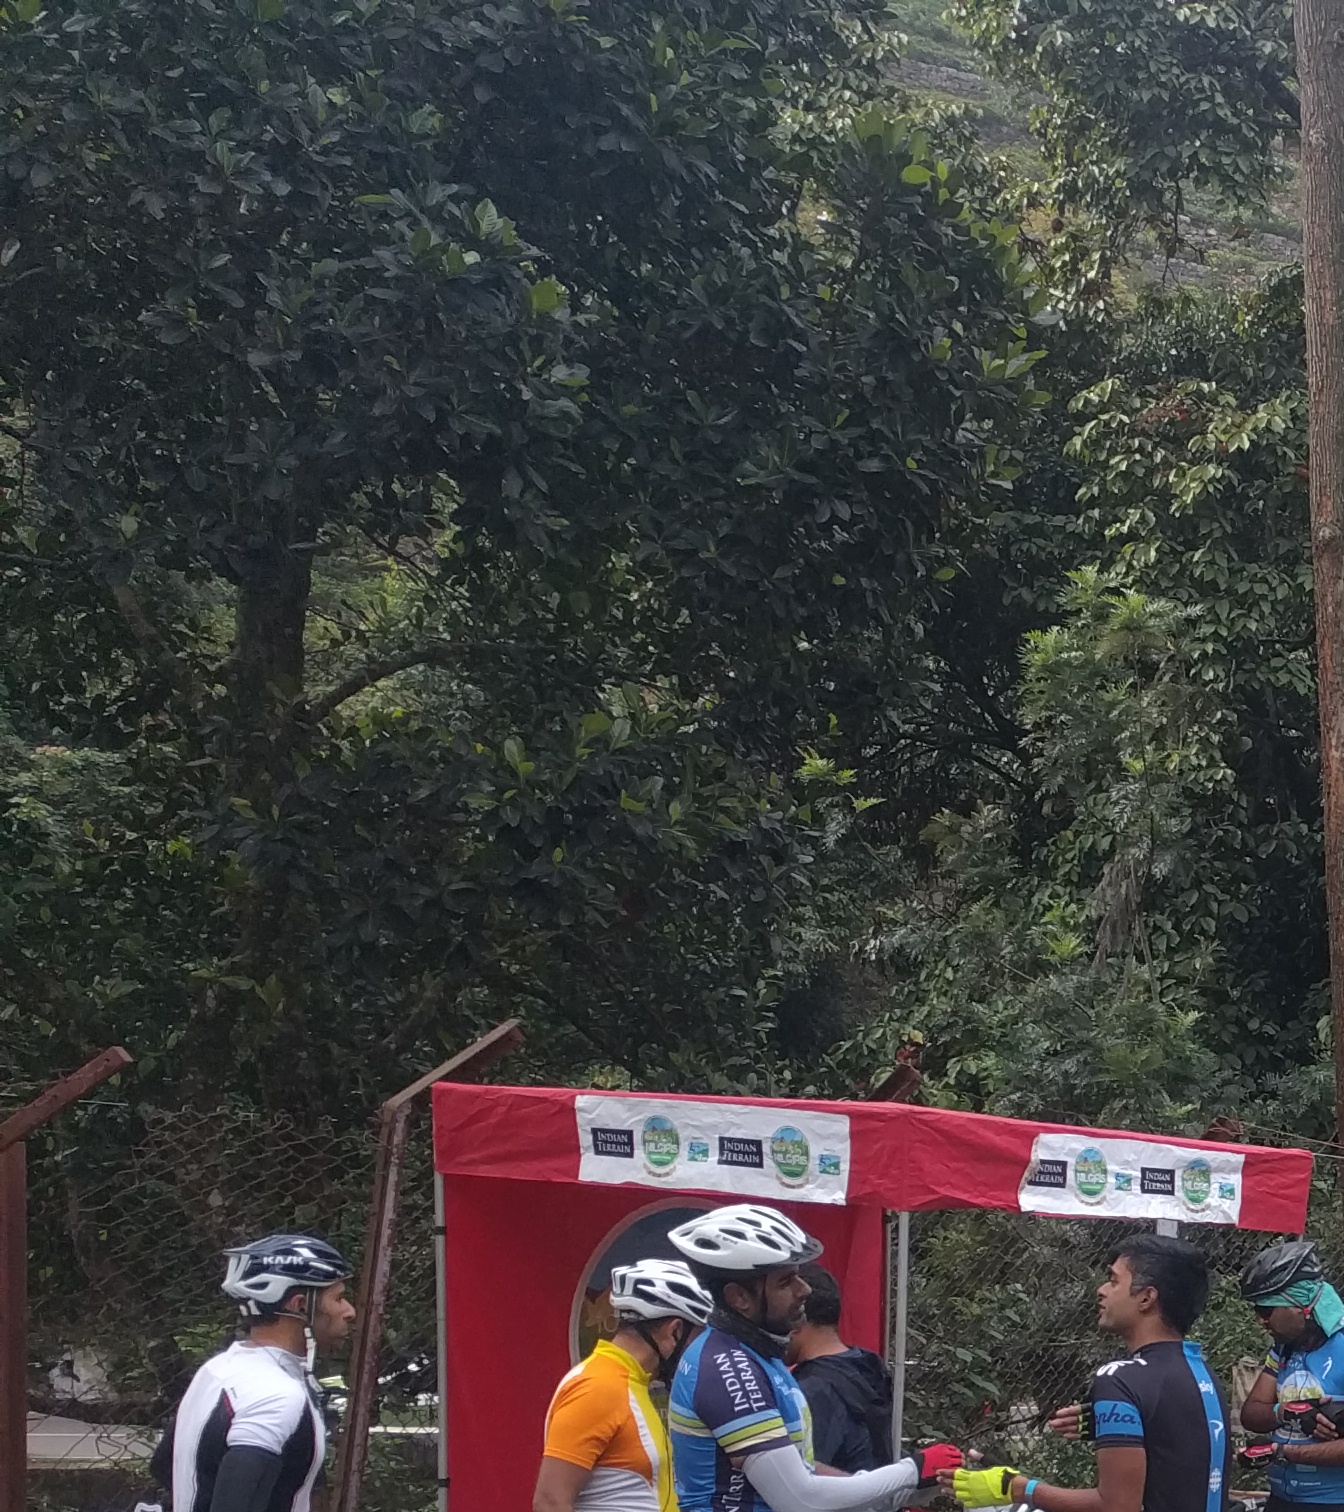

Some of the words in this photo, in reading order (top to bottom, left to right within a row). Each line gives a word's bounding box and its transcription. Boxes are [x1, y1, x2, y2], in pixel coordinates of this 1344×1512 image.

[597, 1131, 629, 1143] INDIAN
[597, 1141, 631, 1154] TERRAIN
[723, 1140, 757, 1152] INDIAN
[721, 1150, 760, 1164] TERRAIN
[1145, 1170, 1171, 1182] INDIAN
[1143, 1180, 1173, 1192] TERRAIN
[263, 1256, 305, 1265] KASK
[714, 1352, 749, 1412] INDIAN
[731, 1348, 766, 1412] TERRAIN
